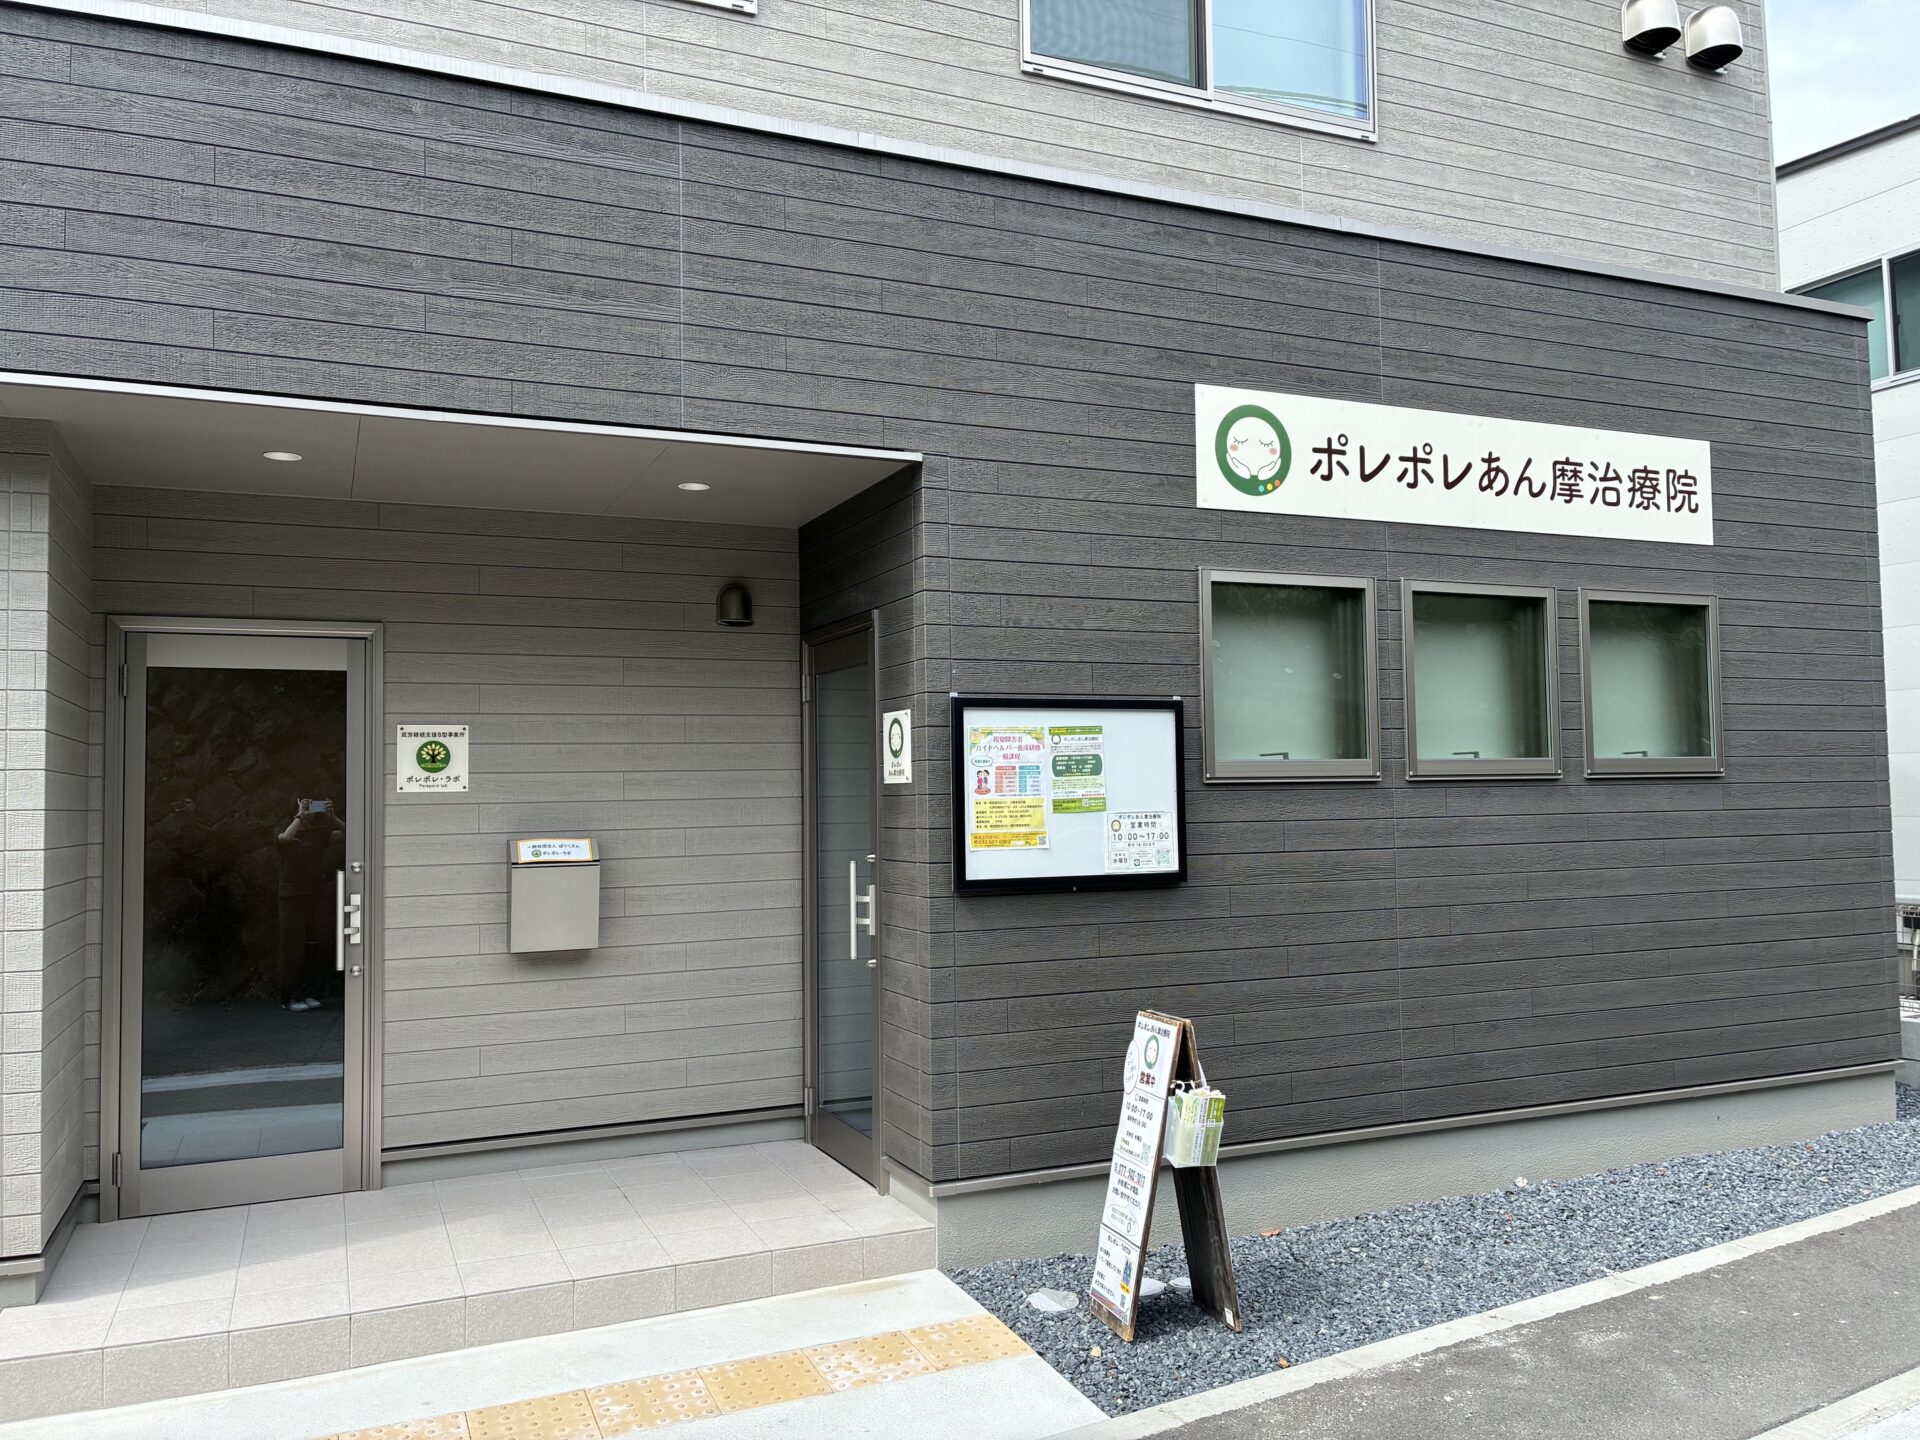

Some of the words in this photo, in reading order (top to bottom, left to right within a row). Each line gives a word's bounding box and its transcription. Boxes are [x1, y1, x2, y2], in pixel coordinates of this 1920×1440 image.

[1310, 433, 1699, 514] ポレポレあん摩治療院
[406, 775, 461, 783] ポレポレ・ラボ
[1130, 821, 1157, 829] 営業時間
[1139, 1070, 1156, 1087] 営業中
